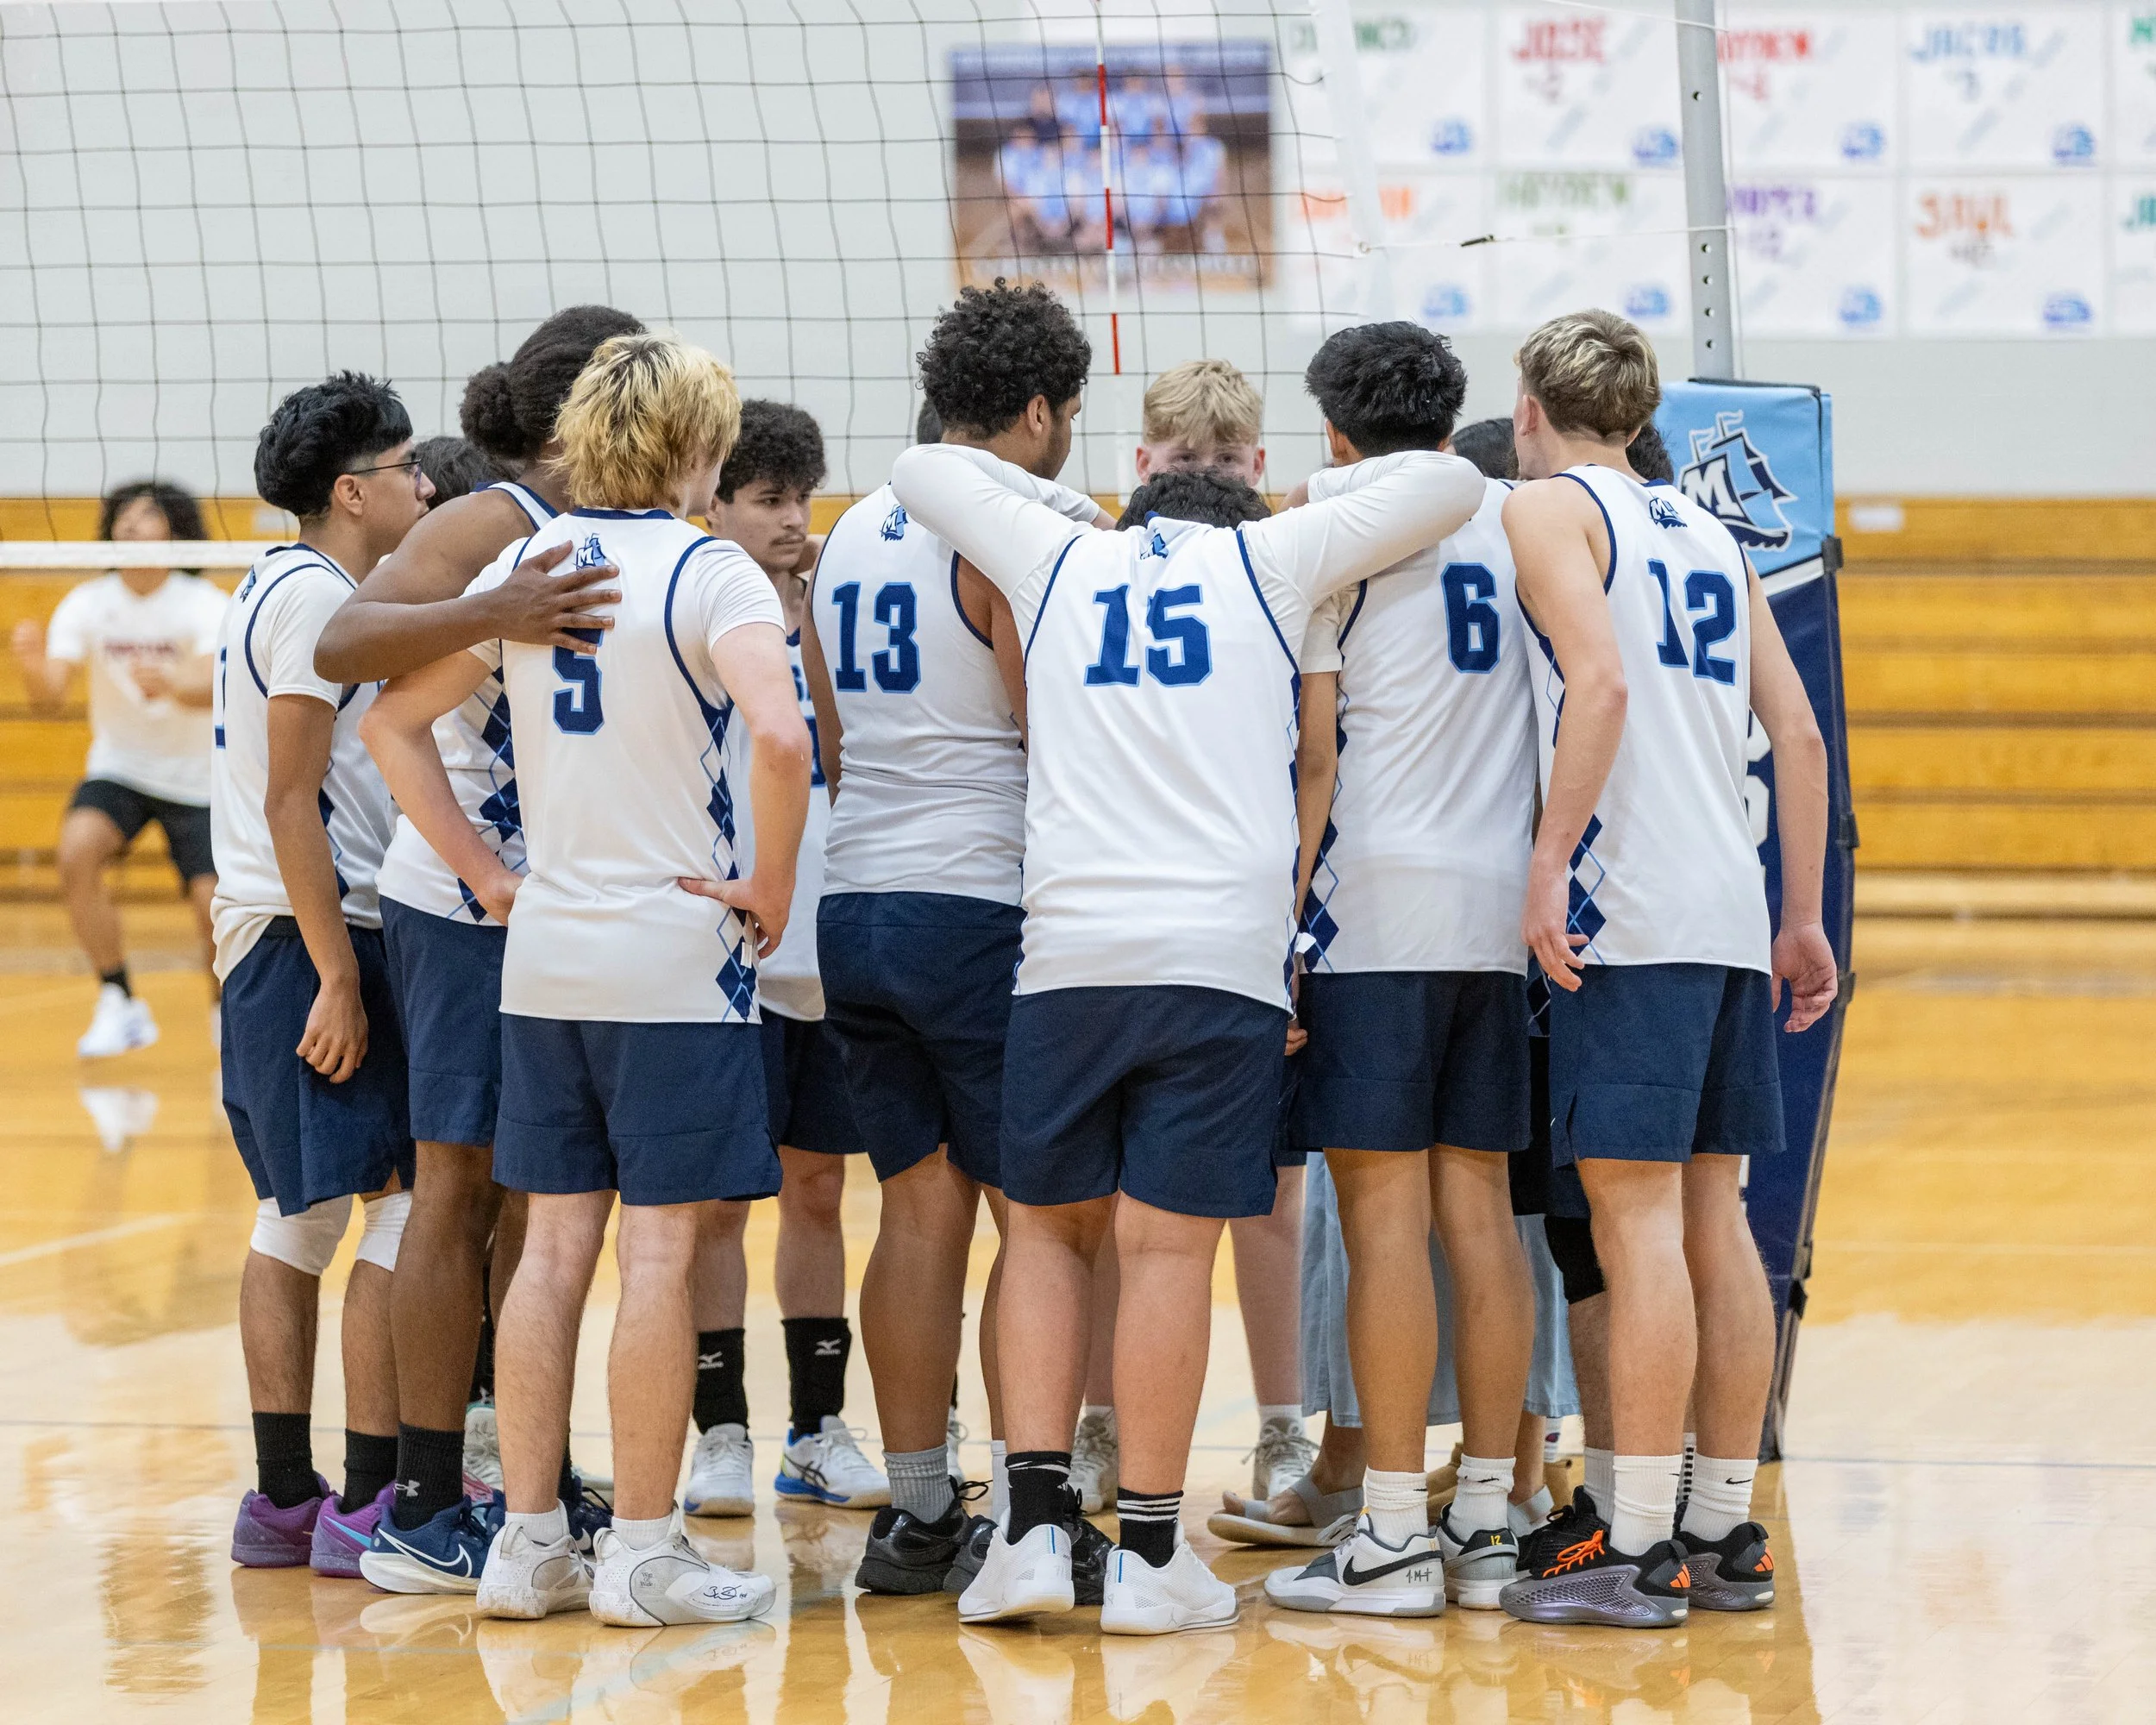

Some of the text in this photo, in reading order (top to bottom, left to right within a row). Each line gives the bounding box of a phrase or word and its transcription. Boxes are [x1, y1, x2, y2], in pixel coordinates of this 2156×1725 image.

[830, 580, 922, 694] 13
[1083, 583, 1214, 688] 15
[1440, 561, 1501, 675] 6
[1647, 558, 1738, 687] 12
[552, 627, 605, 736] 5
[1490, 1535, 1503, 1546] 12
